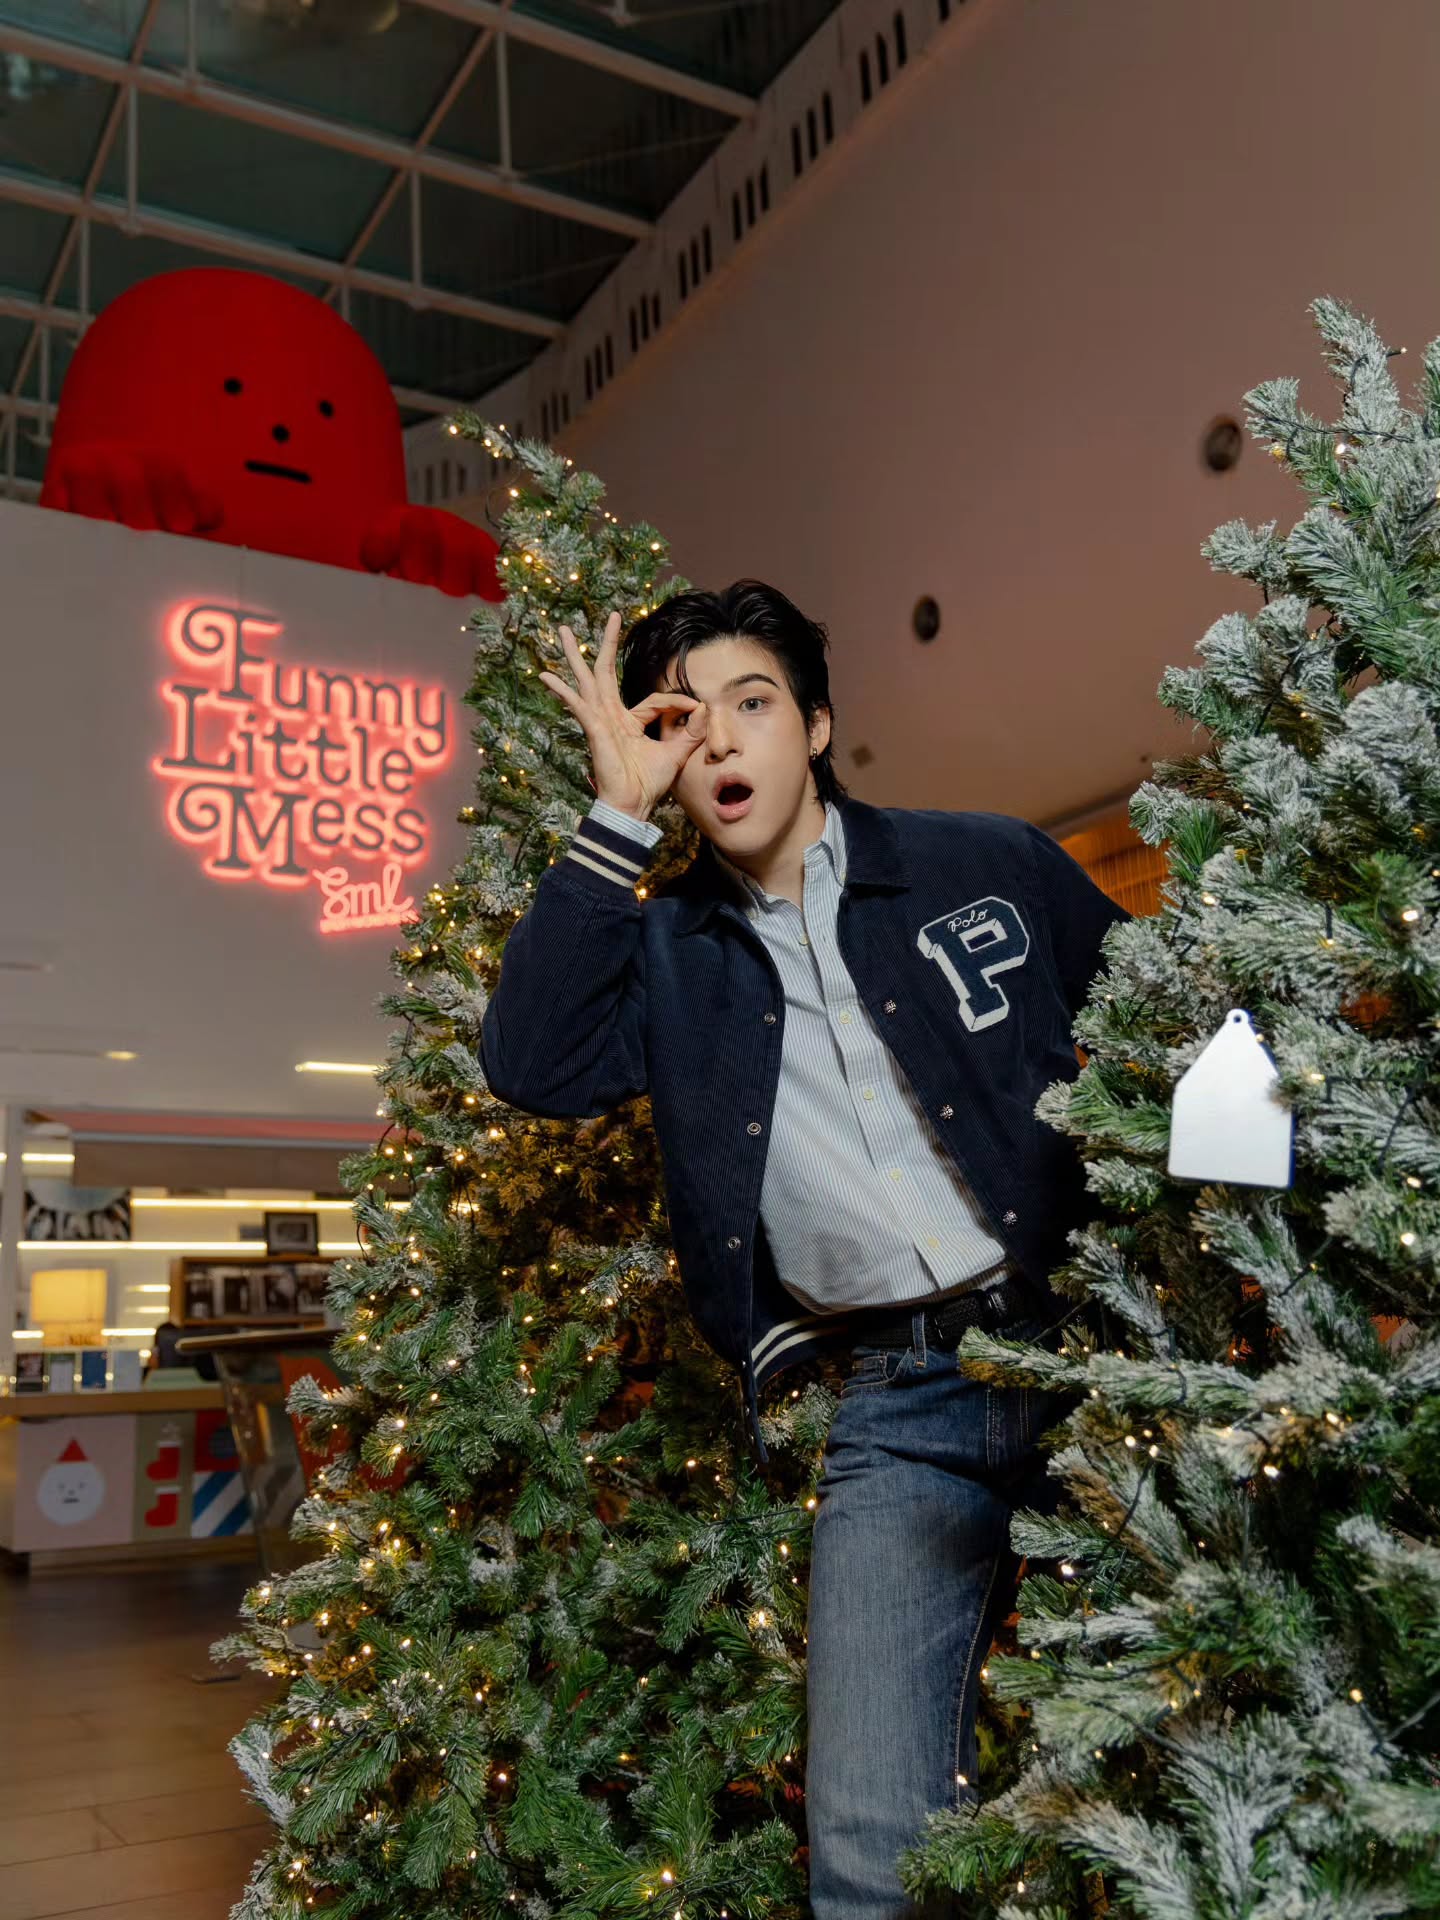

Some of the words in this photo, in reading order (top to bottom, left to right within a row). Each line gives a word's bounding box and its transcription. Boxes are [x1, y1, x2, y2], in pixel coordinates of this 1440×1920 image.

[180, 603, 447, 757] Funny
[159, 683, 415, 796] Little
[175, 782, 426, 876] Mess
[916, 895, 1030, 1033] P
[947, 908, 989, 933] Polo
